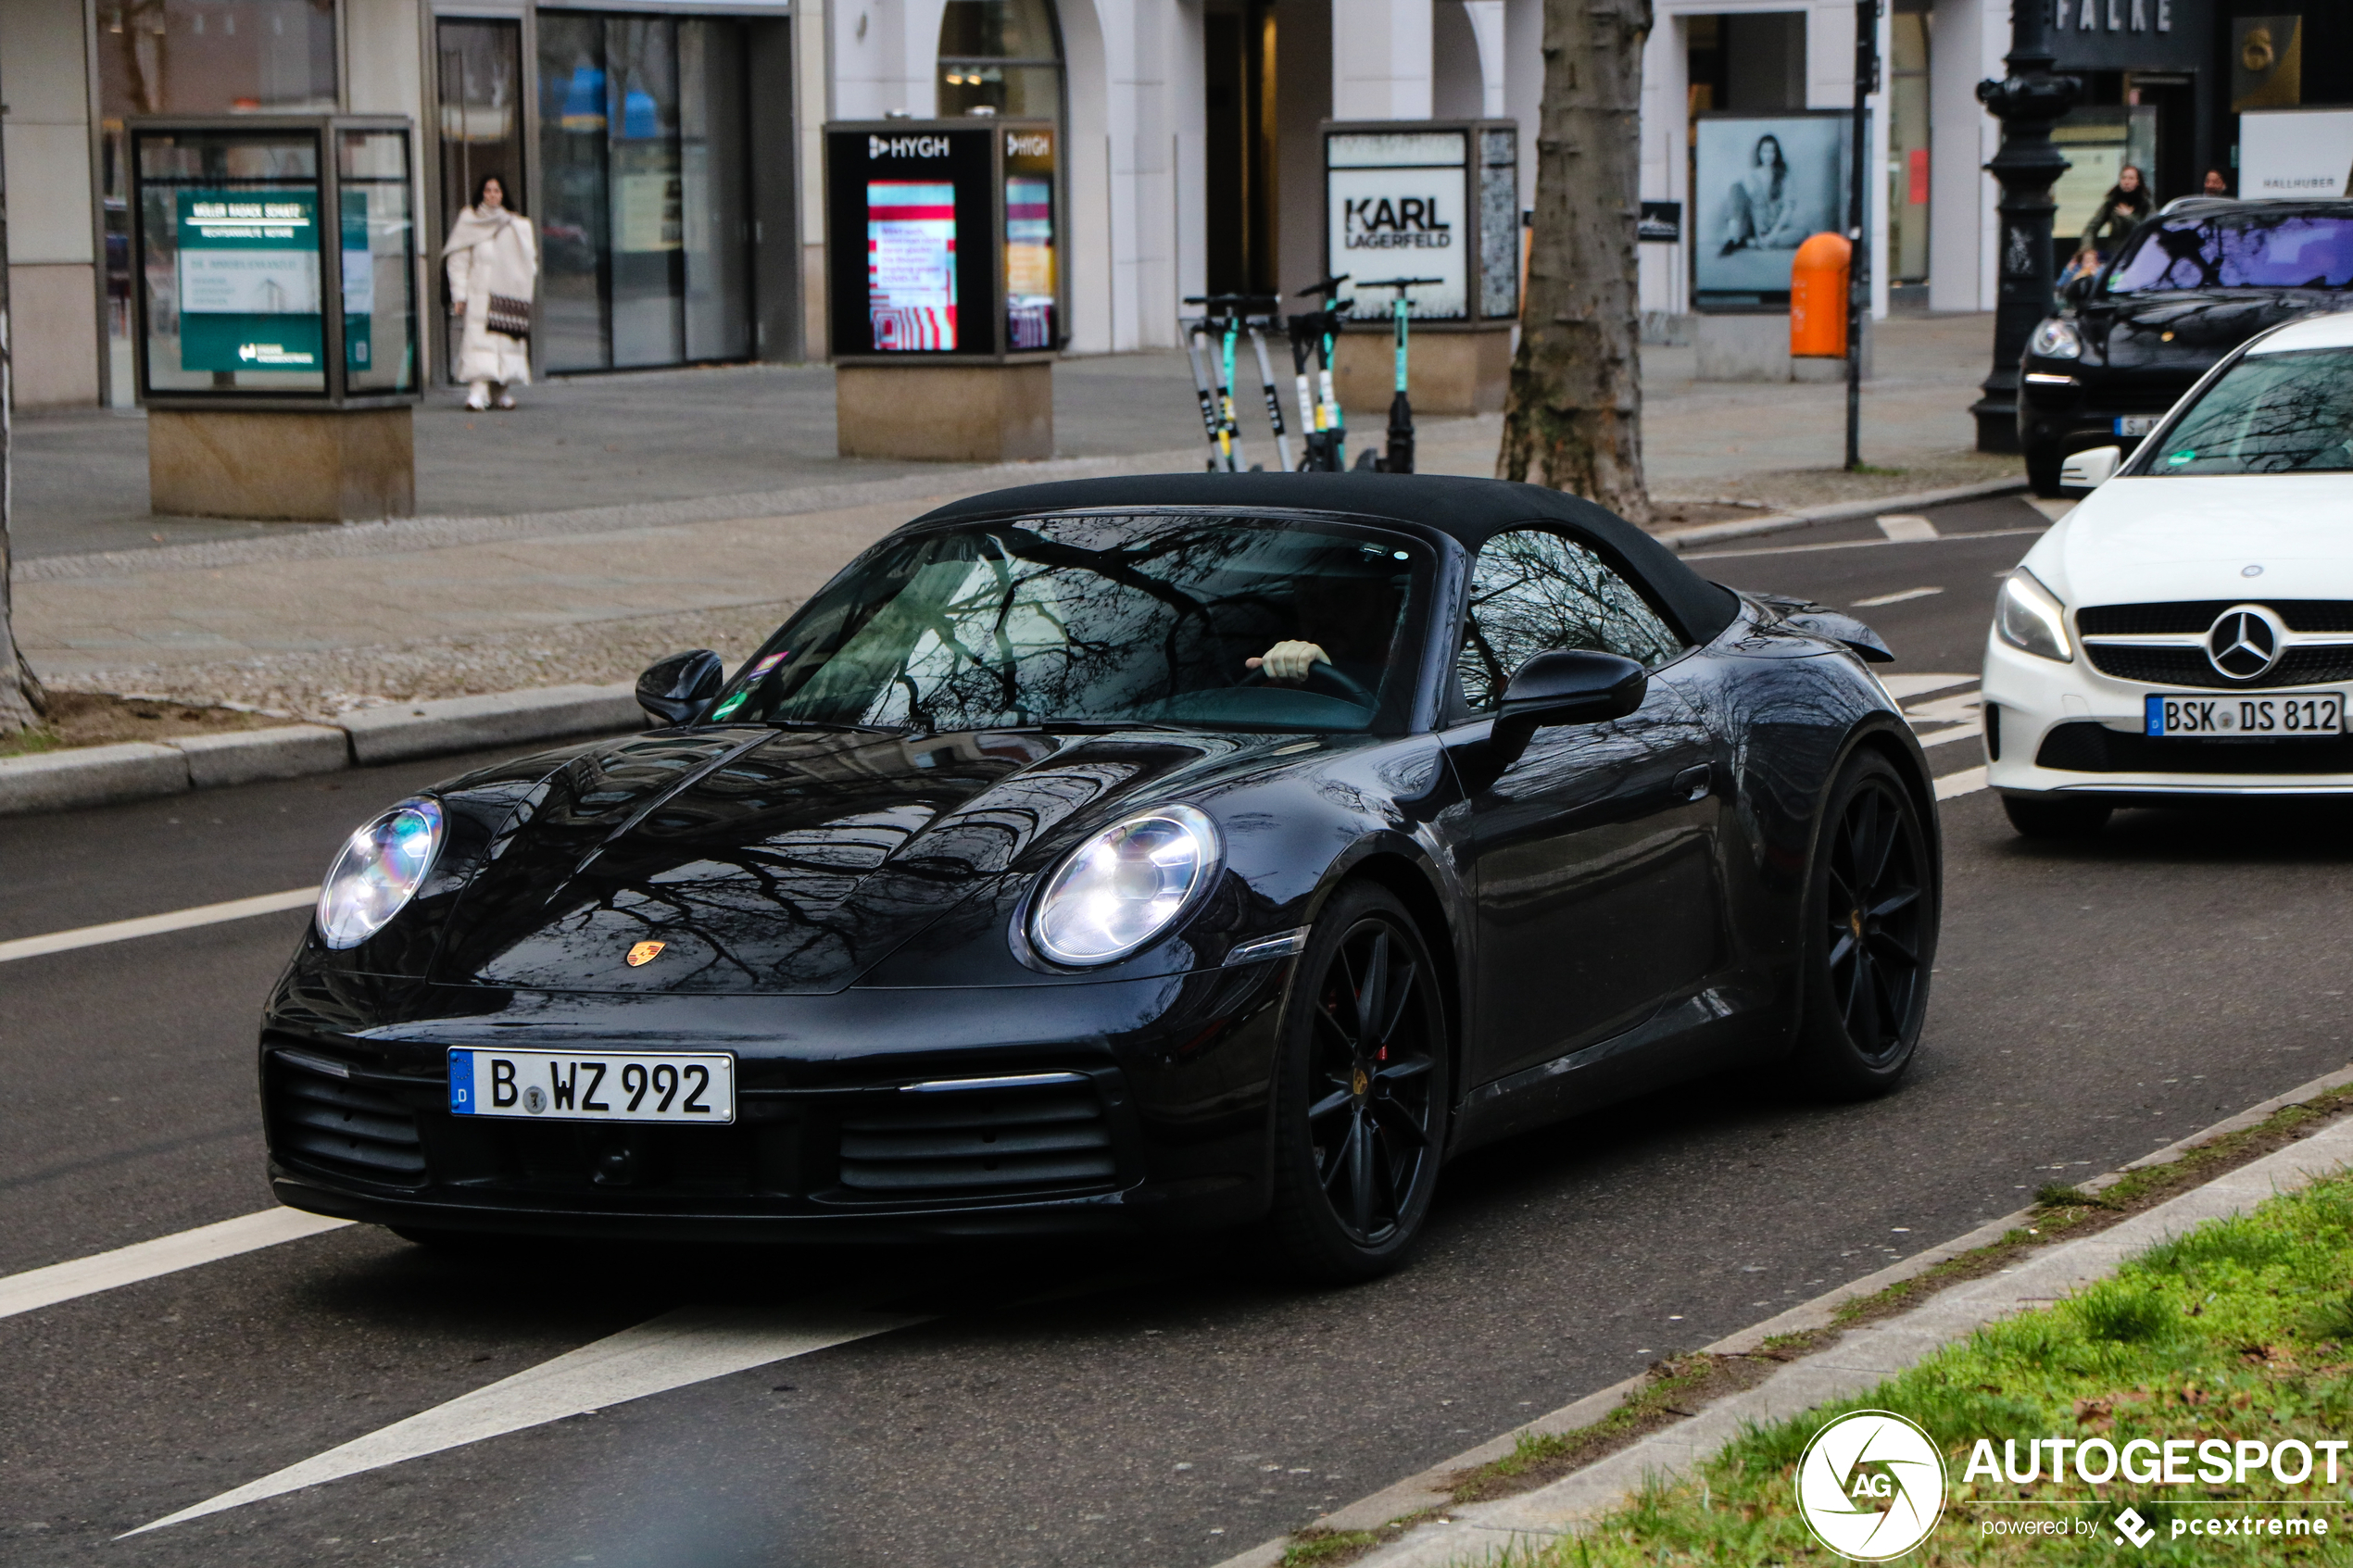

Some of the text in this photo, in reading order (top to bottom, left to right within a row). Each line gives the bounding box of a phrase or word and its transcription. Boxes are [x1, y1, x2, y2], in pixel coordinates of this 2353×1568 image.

[2057, 0, 2171, 31] FALKE
[891, 136, 950, 158] HYGH
[1018, 135, 1050, 157] HYGH
[2263, 177, 2334, 188] HALLHUBER
[1345, 197, 1451, 232] KARL
[1345, 232, 1452, 249] LAGERFELD
[2165, 700, 2337, 732] BSK DS 812
[458, 1087, 468, 1103] D
[491, 1059, 711, 1113] B WZ 992
